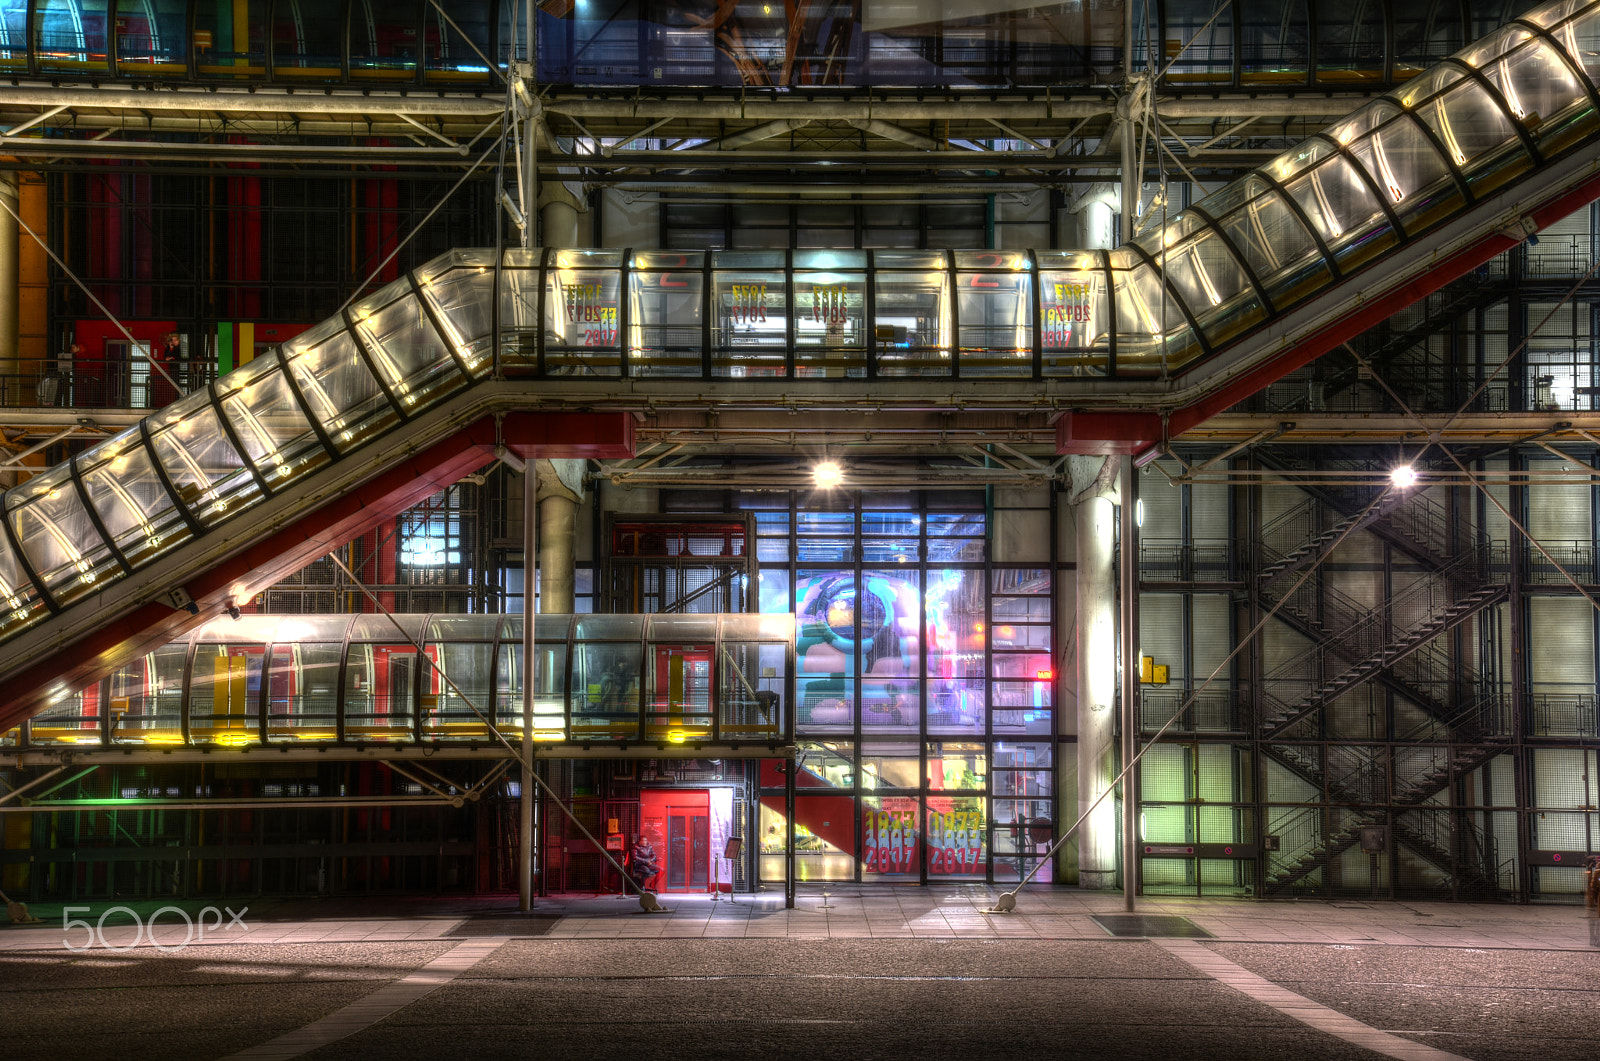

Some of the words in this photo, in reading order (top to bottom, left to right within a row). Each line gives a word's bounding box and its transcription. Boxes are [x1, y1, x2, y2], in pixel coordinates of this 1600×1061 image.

[585, 329, 617, 346] 2017
[1041, 331, 1072, 347] 2017
[865, 847, 916, 872] 2017
[931, 848, 981, 873] 2017
